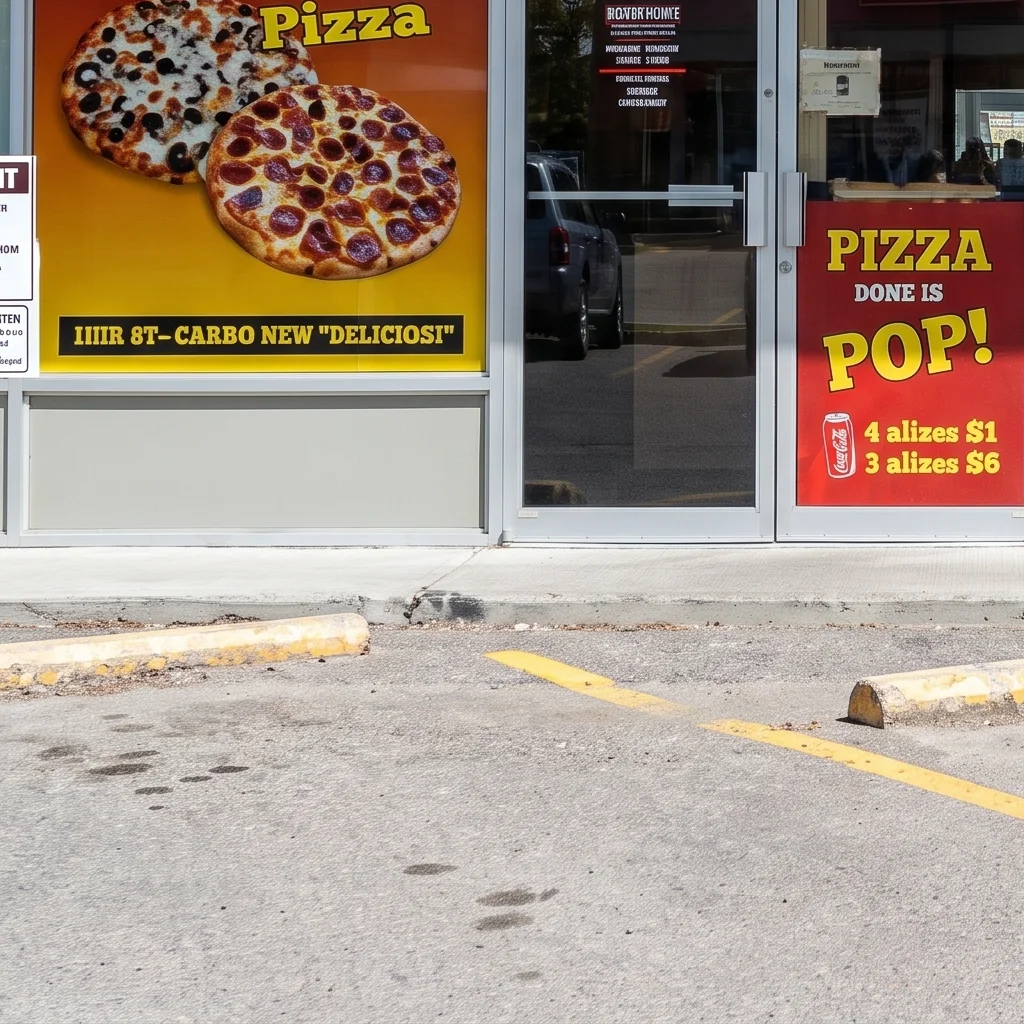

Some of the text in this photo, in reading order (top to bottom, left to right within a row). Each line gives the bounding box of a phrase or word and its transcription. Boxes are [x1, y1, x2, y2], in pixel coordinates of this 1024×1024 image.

[260, 1, 430, 49] Pizza
[828, 229, 992, 271] PIZZA
[855, 283, 944, 303] DONE IS
[261, 326, 313, 345] NEW
[824, 307, 993, 392] POP!
[863, 418, 998, 444] 4 alizes $1
[864, 451, 880, 475] 3
[886, 450, 960, 475] alizes
[965, 449, 1001, 476] $6
